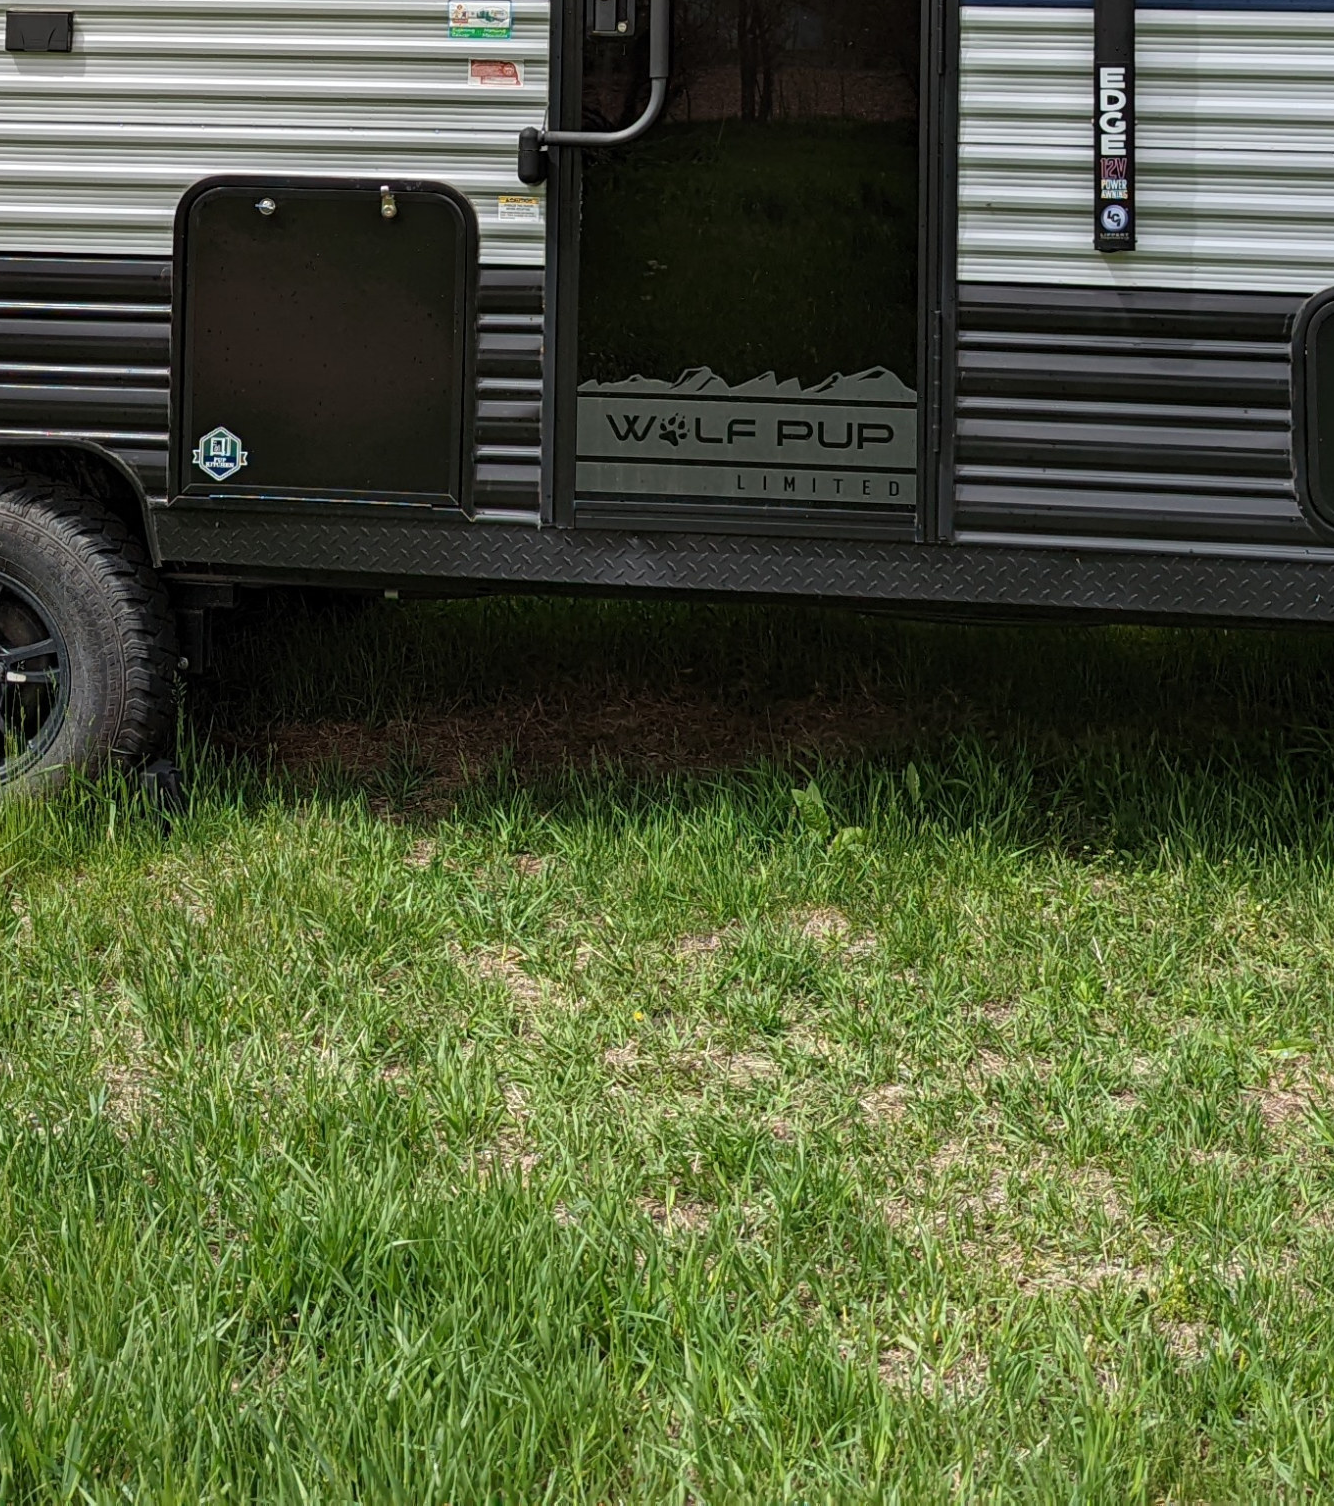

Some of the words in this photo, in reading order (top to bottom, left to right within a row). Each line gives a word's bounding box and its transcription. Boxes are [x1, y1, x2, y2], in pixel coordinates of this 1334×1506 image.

[1099, 67, 1127, 156] EDGE
[1100, 158, 1128, 179] 12V
[1101, 179, 1128, 190] POWER
[1101, 190, 1129, 199] AWNING
[777, 420, 895, 450] PUP
[737, 474, 900, 497] LIMITED
